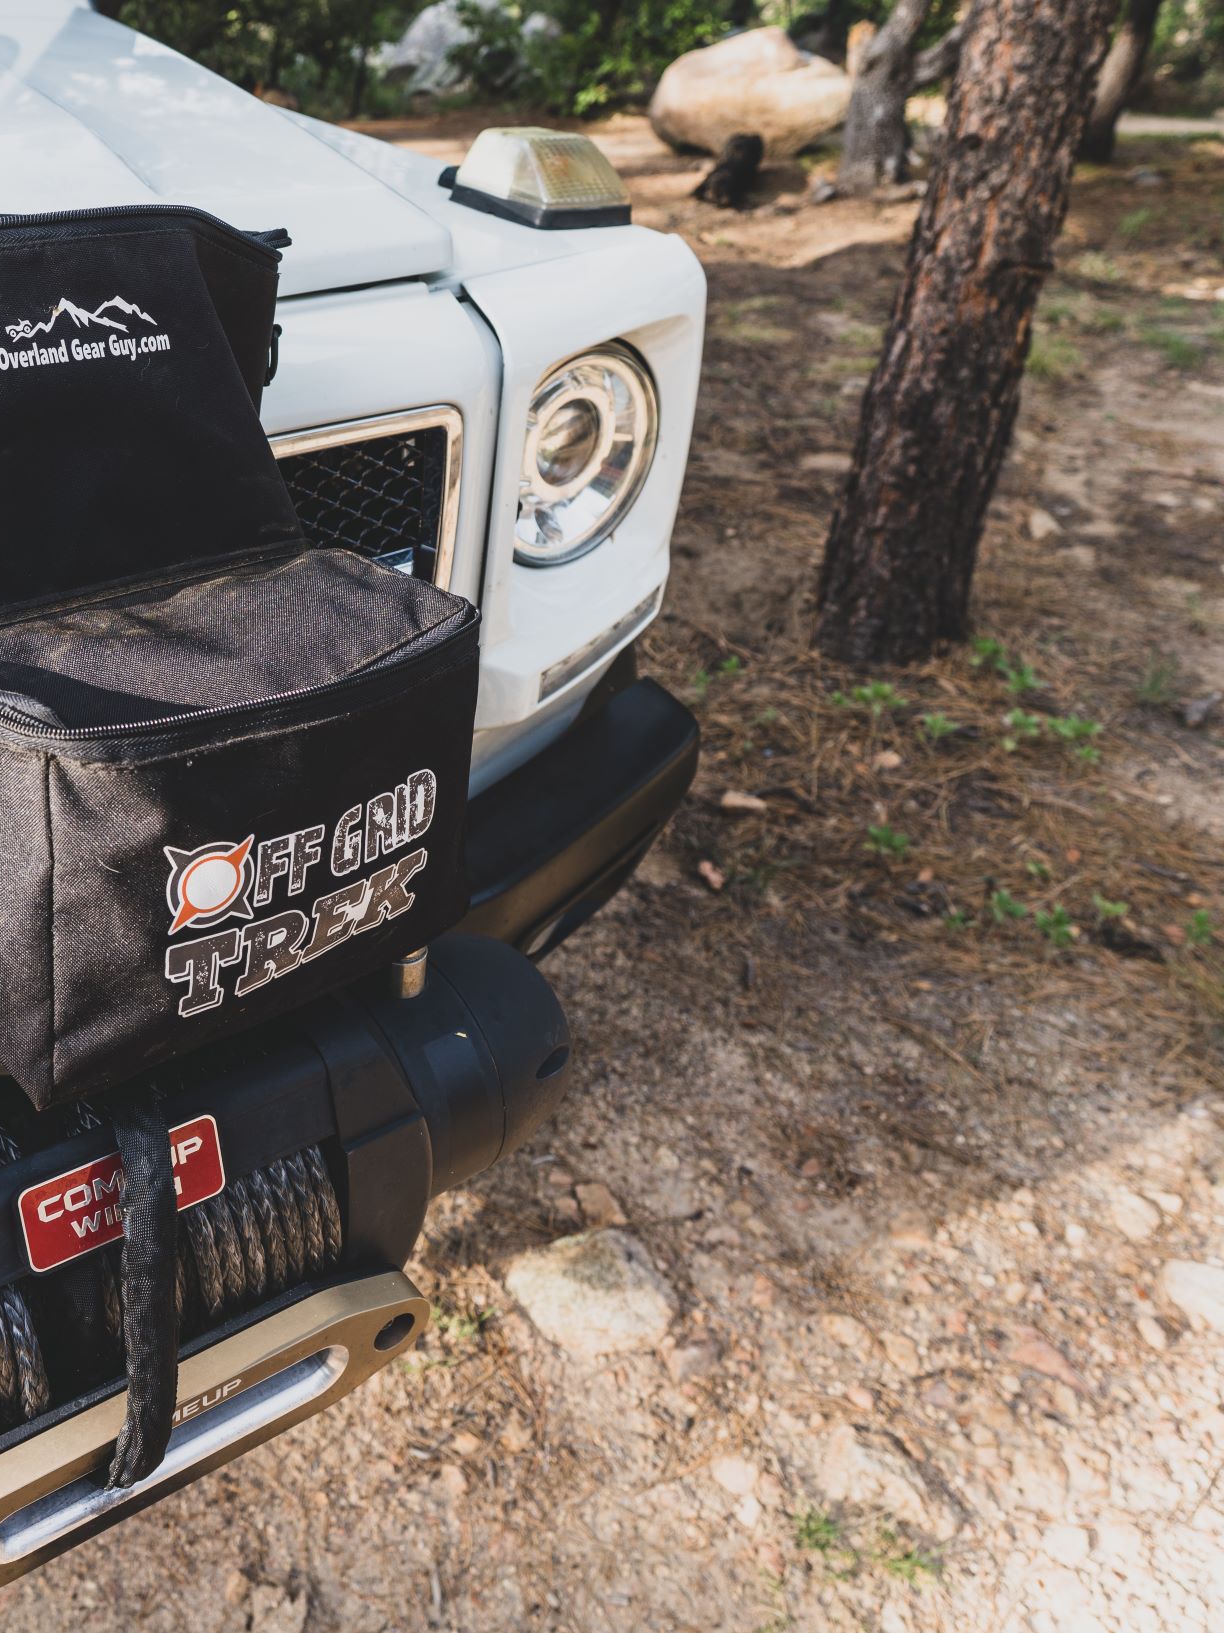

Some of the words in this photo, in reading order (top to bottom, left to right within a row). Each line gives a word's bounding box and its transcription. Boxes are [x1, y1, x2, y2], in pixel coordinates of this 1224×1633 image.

[71, 339, 106, 361] Gear
[109, 333, 171, 361] Guy.com
[331, 768, 436, 876] GRID
[165, 848, 428, 1018] TREK
[37, 1136, 203, 1223] COMP
